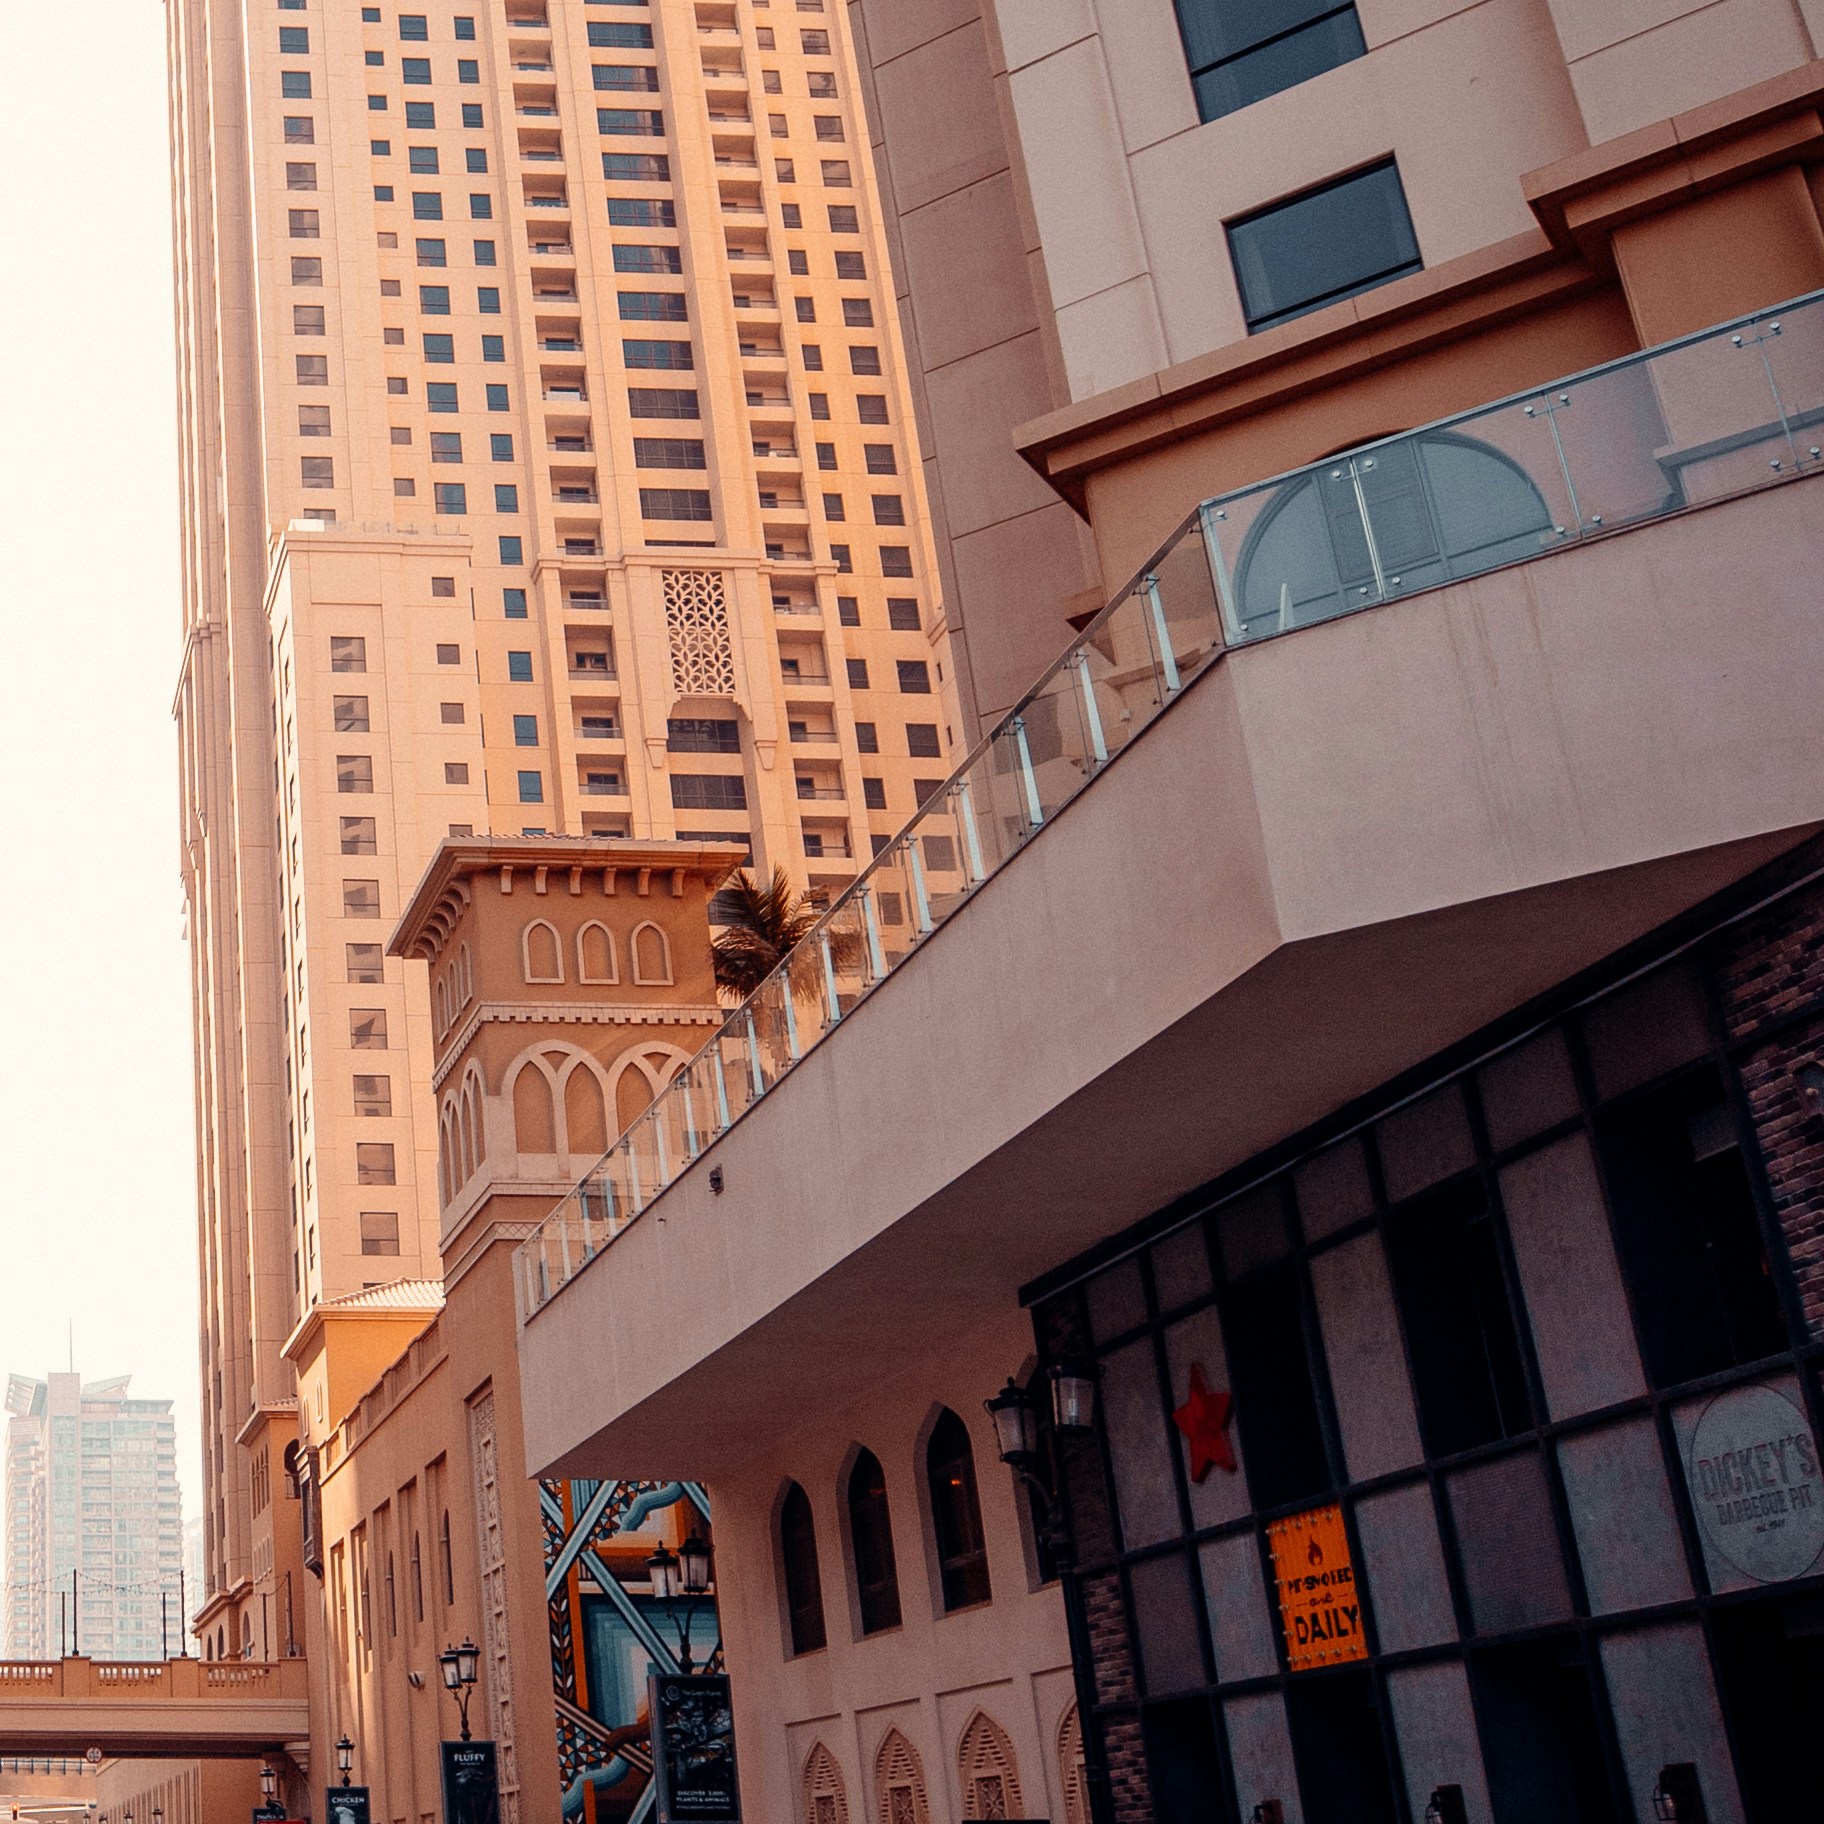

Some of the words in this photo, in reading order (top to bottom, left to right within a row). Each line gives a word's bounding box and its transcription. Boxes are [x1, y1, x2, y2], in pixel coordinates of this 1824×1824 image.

[1294, 1604, 1358, 1645] DAILY
[453, 1753, 486, 1762] FLUFFY
[331, 1796, 365, 1804] CHICKEN
